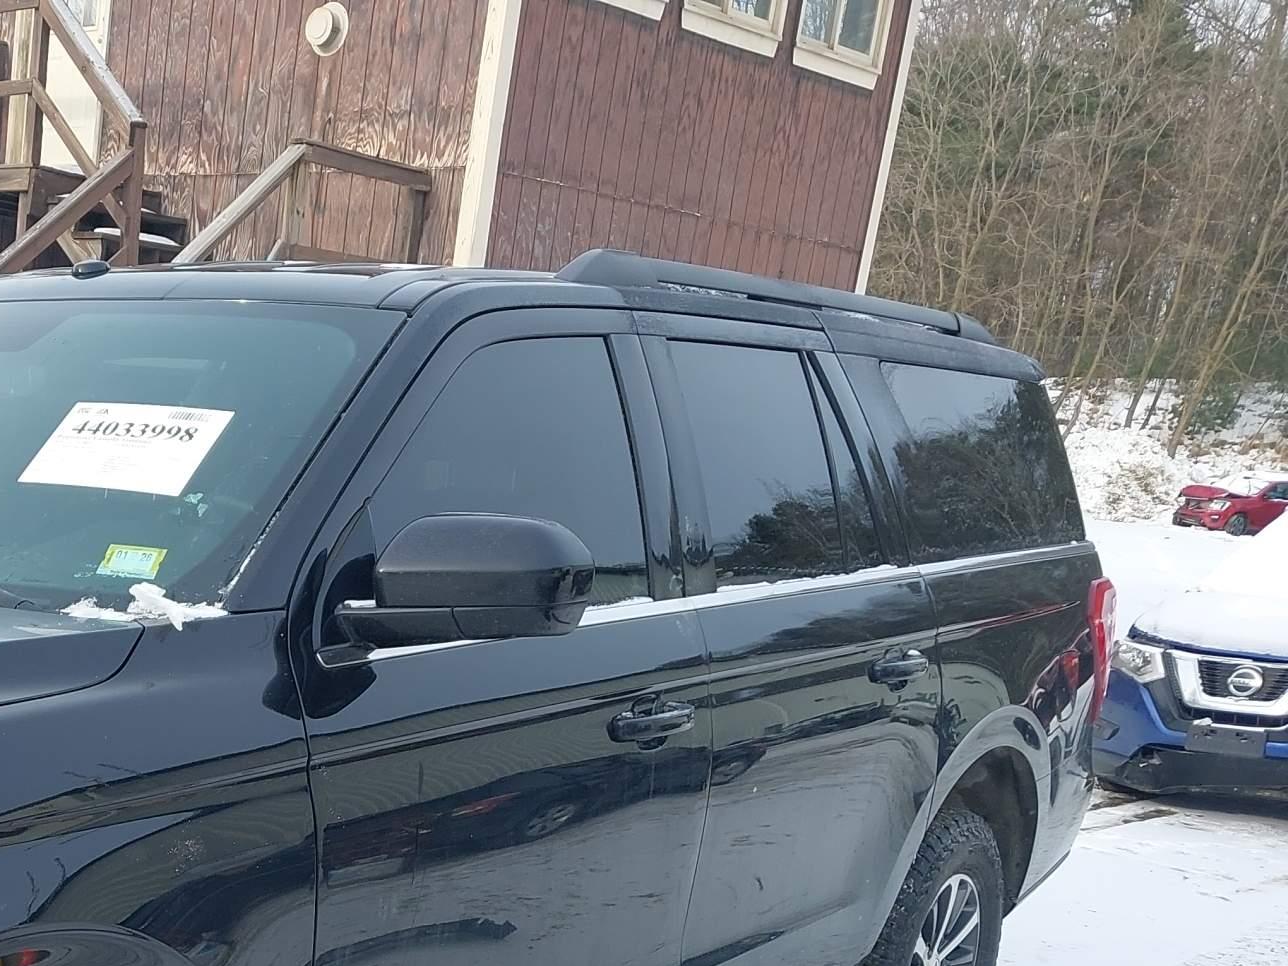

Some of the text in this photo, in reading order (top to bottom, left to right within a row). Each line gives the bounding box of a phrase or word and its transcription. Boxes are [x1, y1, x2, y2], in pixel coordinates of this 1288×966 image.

[72, 420, 199, 443] 44033998
[116, 550, 153, 562] 01 26
